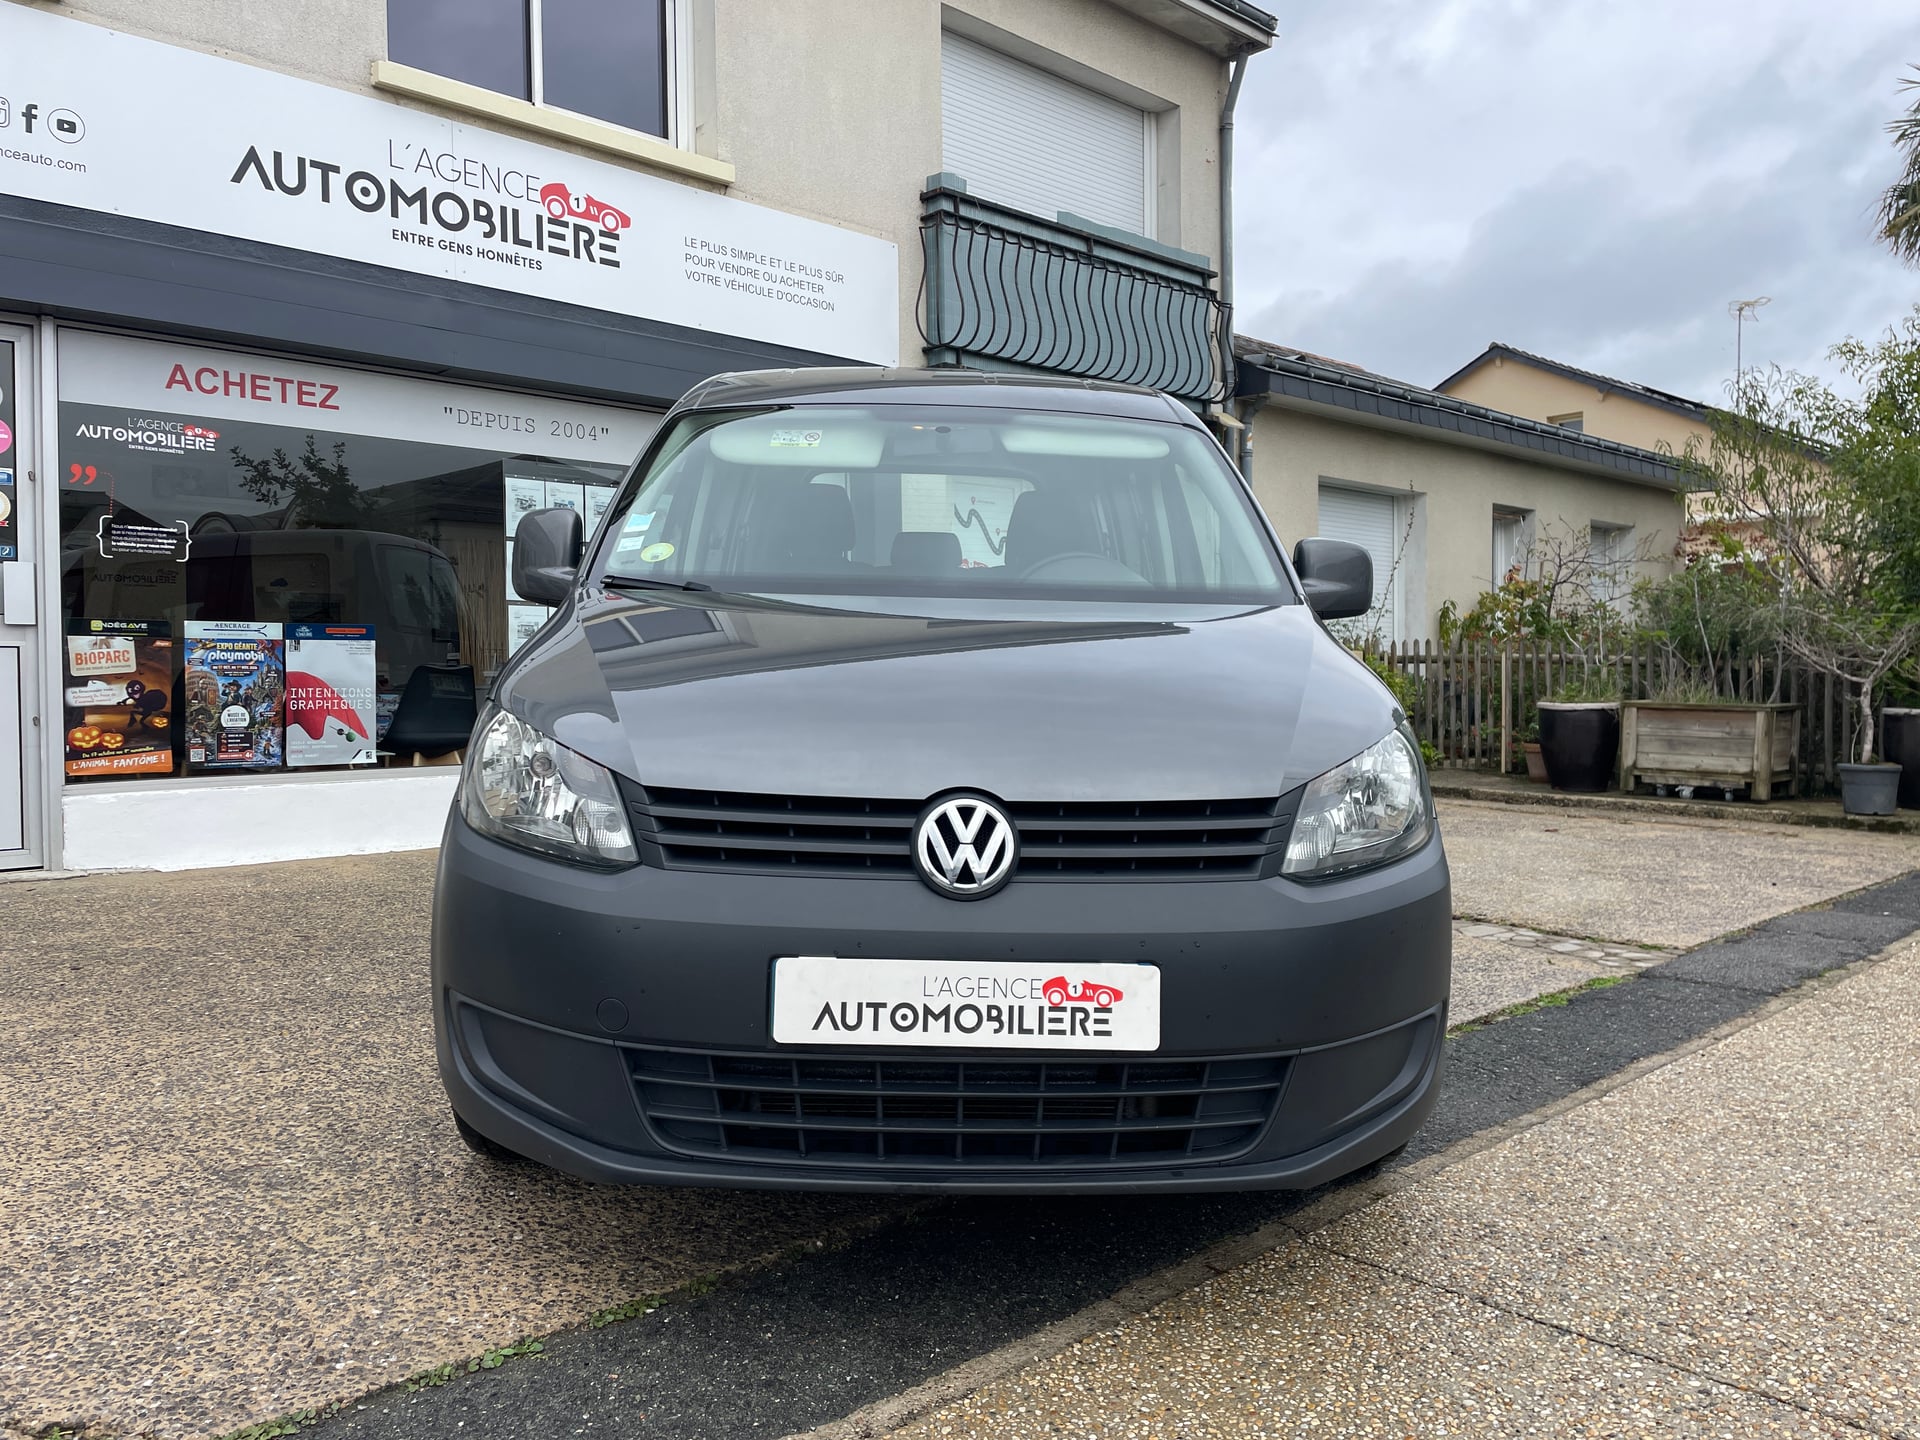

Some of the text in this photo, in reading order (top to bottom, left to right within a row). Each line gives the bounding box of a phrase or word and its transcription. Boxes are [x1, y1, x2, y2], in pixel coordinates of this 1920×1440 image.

[389, 138, 541, 204] L'AGENCE
[392, 228, 543, 271] ENTRE GENS HONNÊTES
[684, 236, 845, 284] LE PLUS SIMPLE ET LE PLUS SÛR
[685, 252, 825, 295] POUR VENDRE OU ACHETER
[685, 269, 835, 312] VOTRE VÉHICULE D'OCCASION
[165, 363, 340, 410] ACHETEZ
[127, 417, 184, 433] L'AGENCE
[443, 406, 609, 441] "DEPUIS 2004"
[208, 650, 265, 663] playmobil
[216, 641, 258, 650] EXPO GÉANTE
[290, 687, 372, 698] INTENTIONS
[290, 699, 372, 710] GRAPHIQUES
[72, 760, 111, 770] L'ANIMAL
[113, 754, 158, 768] FANTÔME
[919, 799, 1013, 893] VW
[923, 975, 1043, 1000] L'AGENCE
